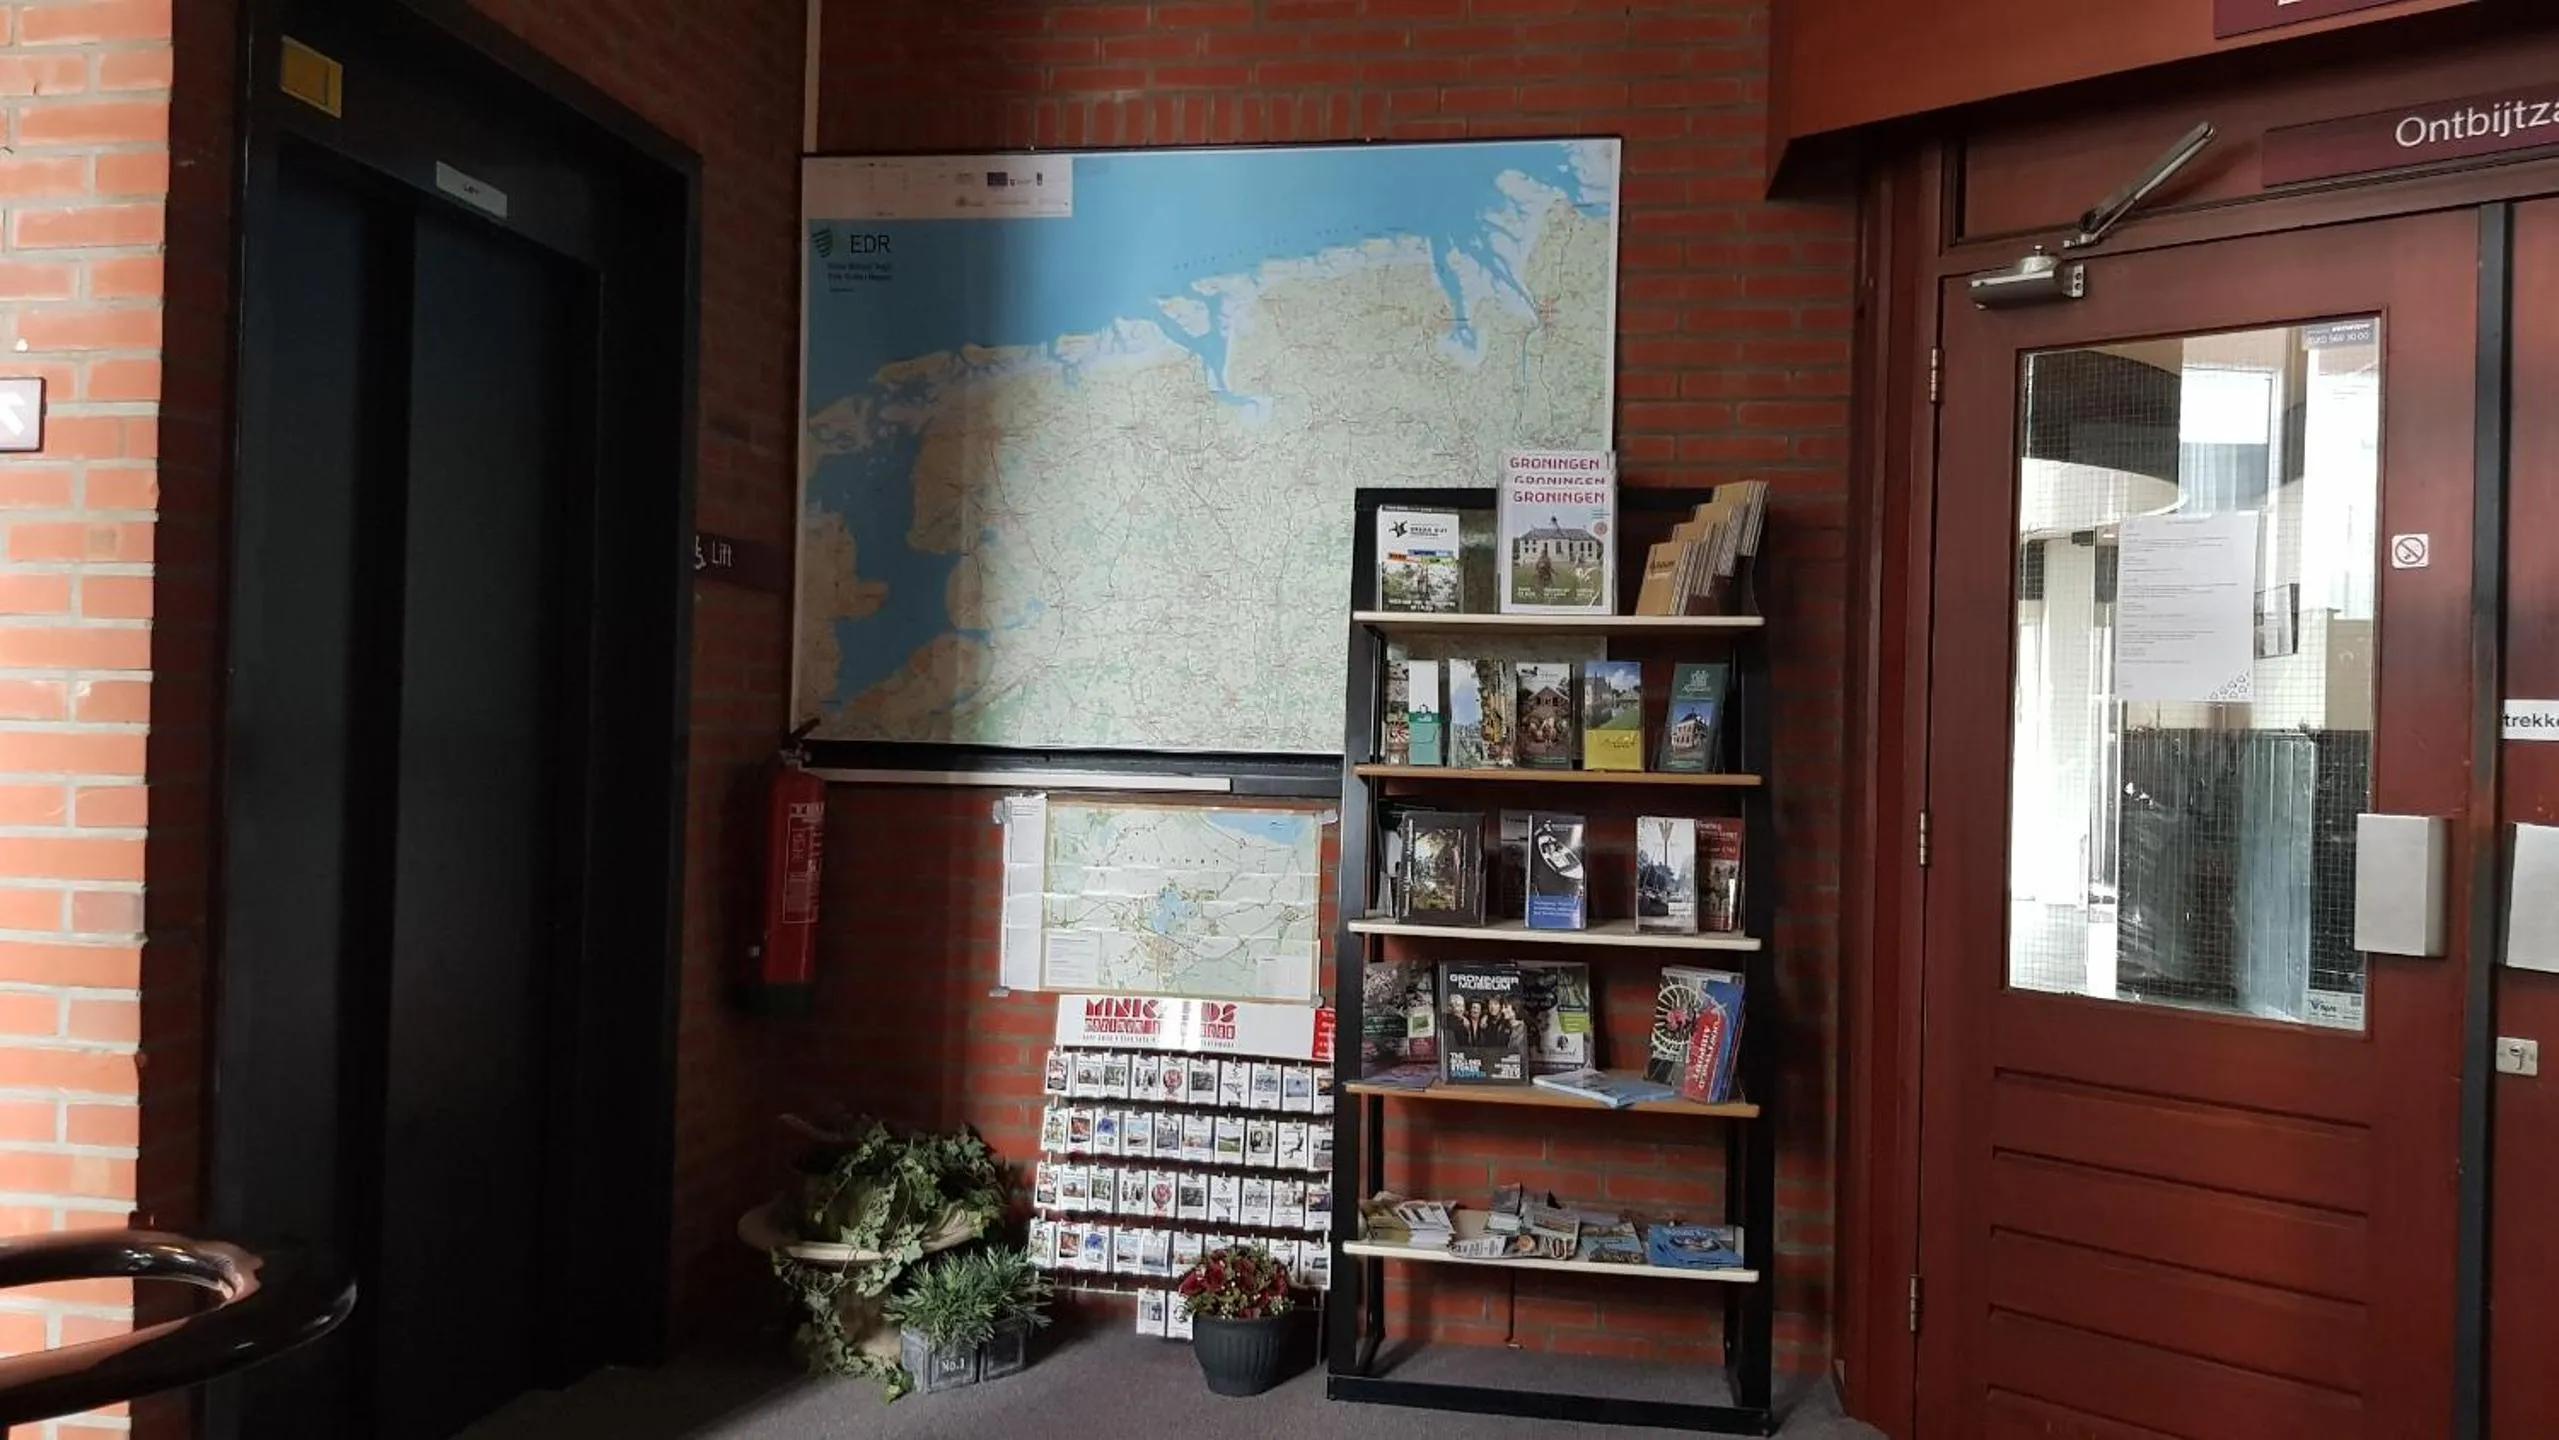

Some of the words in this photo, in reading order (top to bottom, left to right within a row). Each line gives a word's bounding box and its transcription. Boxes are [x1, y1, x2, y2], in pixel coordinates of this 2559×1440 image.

[850, 234, 892, 254] EDR
[1509, 456, 1600, 470] GRONINGEN
[1514, 475, 1605, 485] GRONINGEN
[1513, 491, 1605, 504] GRONINGEN
[2503, 712, 2559, 728] trekk
[1449, 973, 1519, 985] GRONINGER
[1458, 981, 1511, 991] MUSEUM
[1086, 997, 1238, 1023] MINICDS
